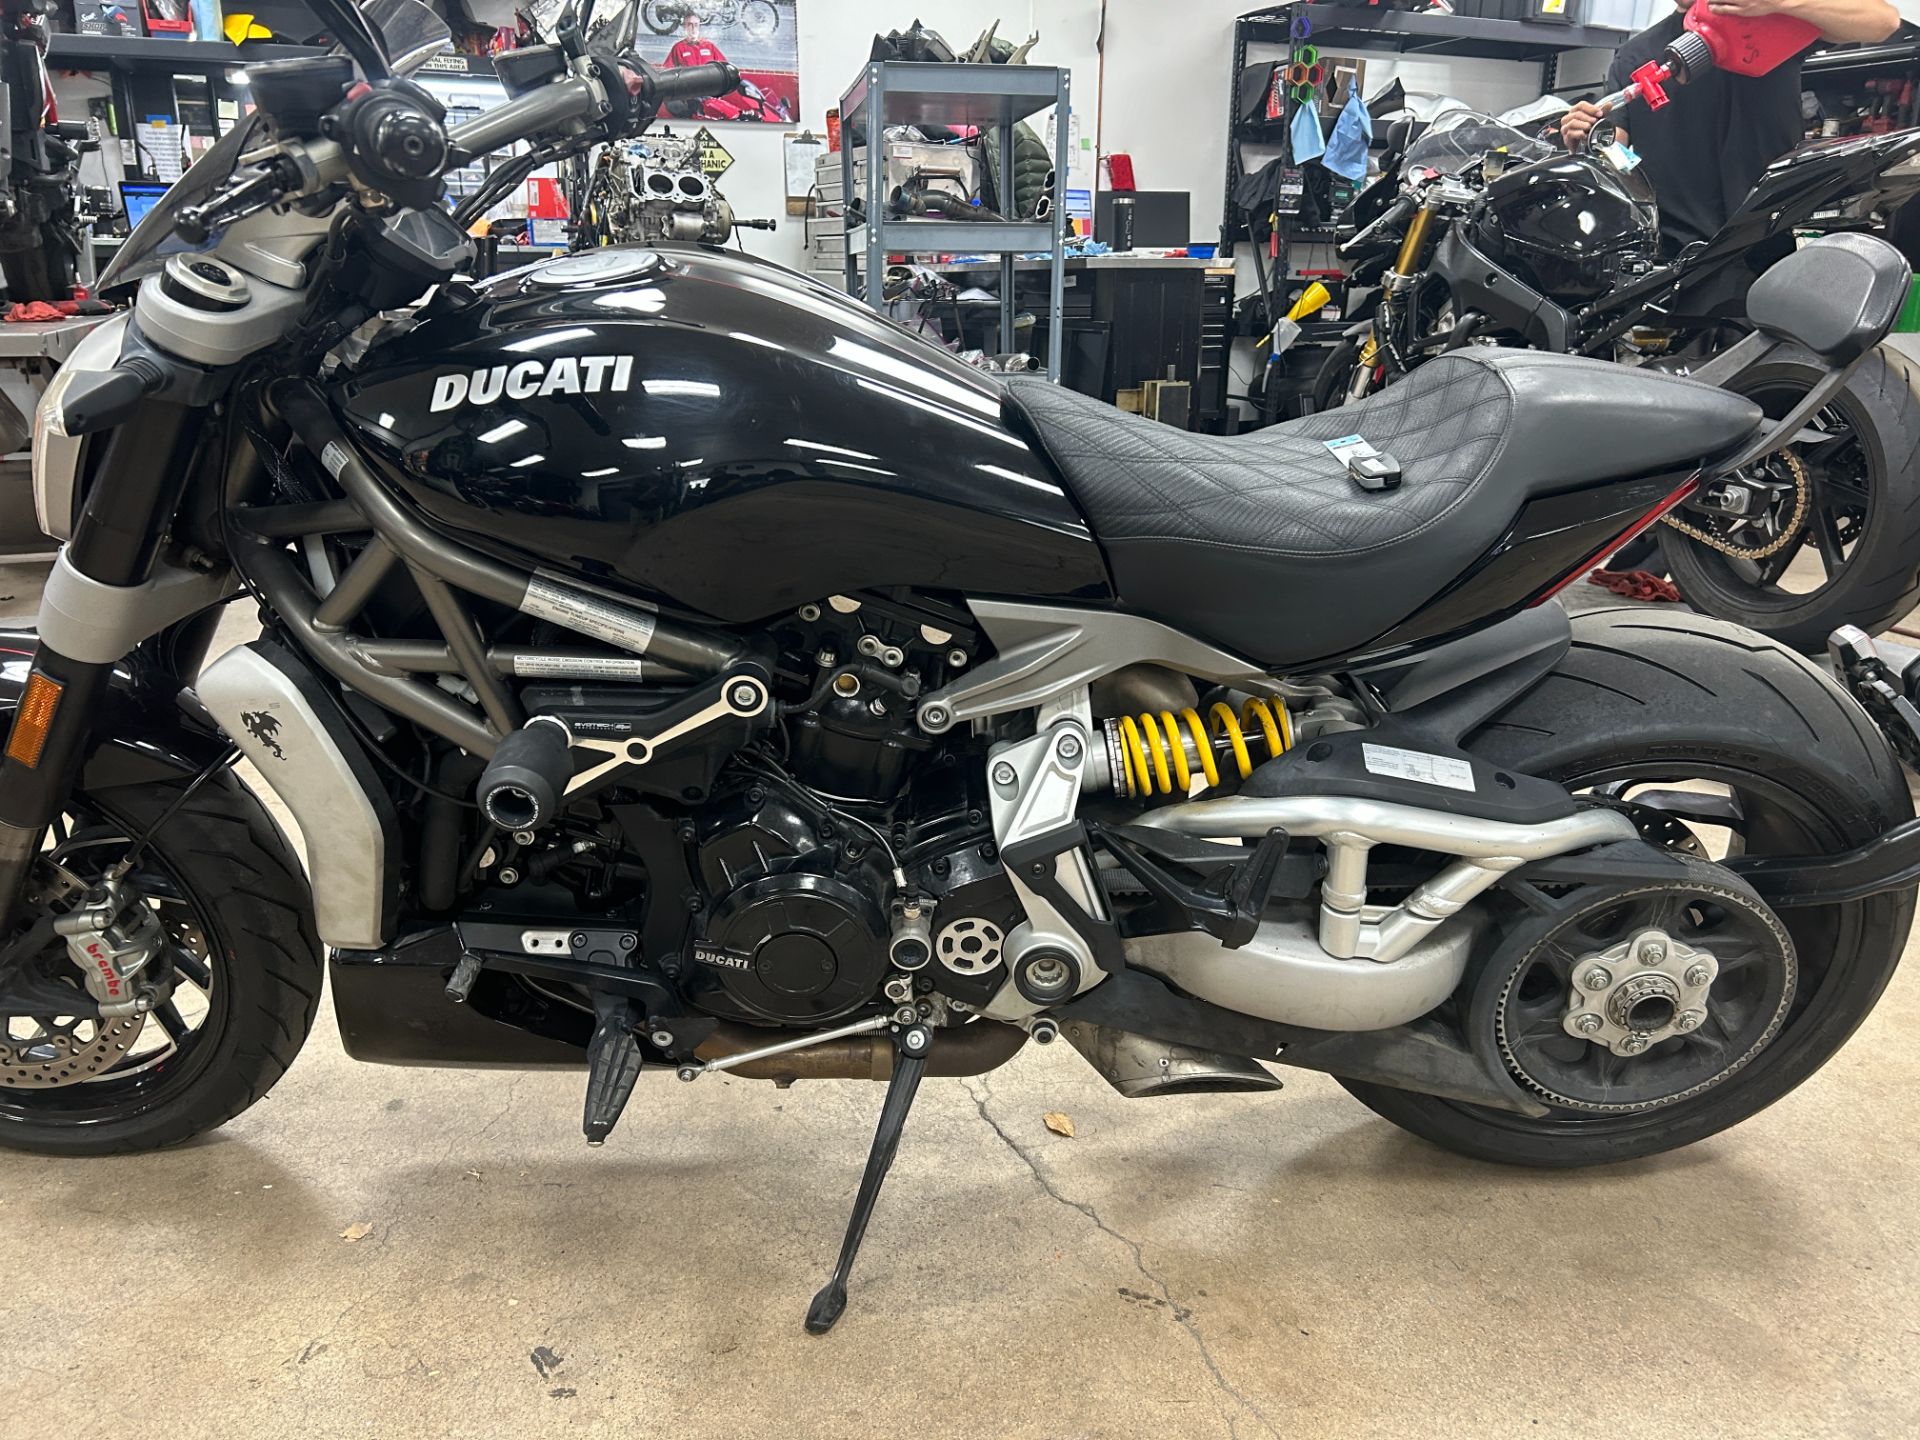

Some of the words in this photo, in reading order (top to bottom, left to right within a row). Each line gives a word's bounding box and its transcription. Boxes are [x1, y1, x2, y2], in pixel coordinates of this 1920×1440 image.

[709, 150, 715, 158] A
[429, 355, 634, 413] DUCATI
[86, 943, 120, 996] brembo
[694, 950, 749, 969] DUCATI
